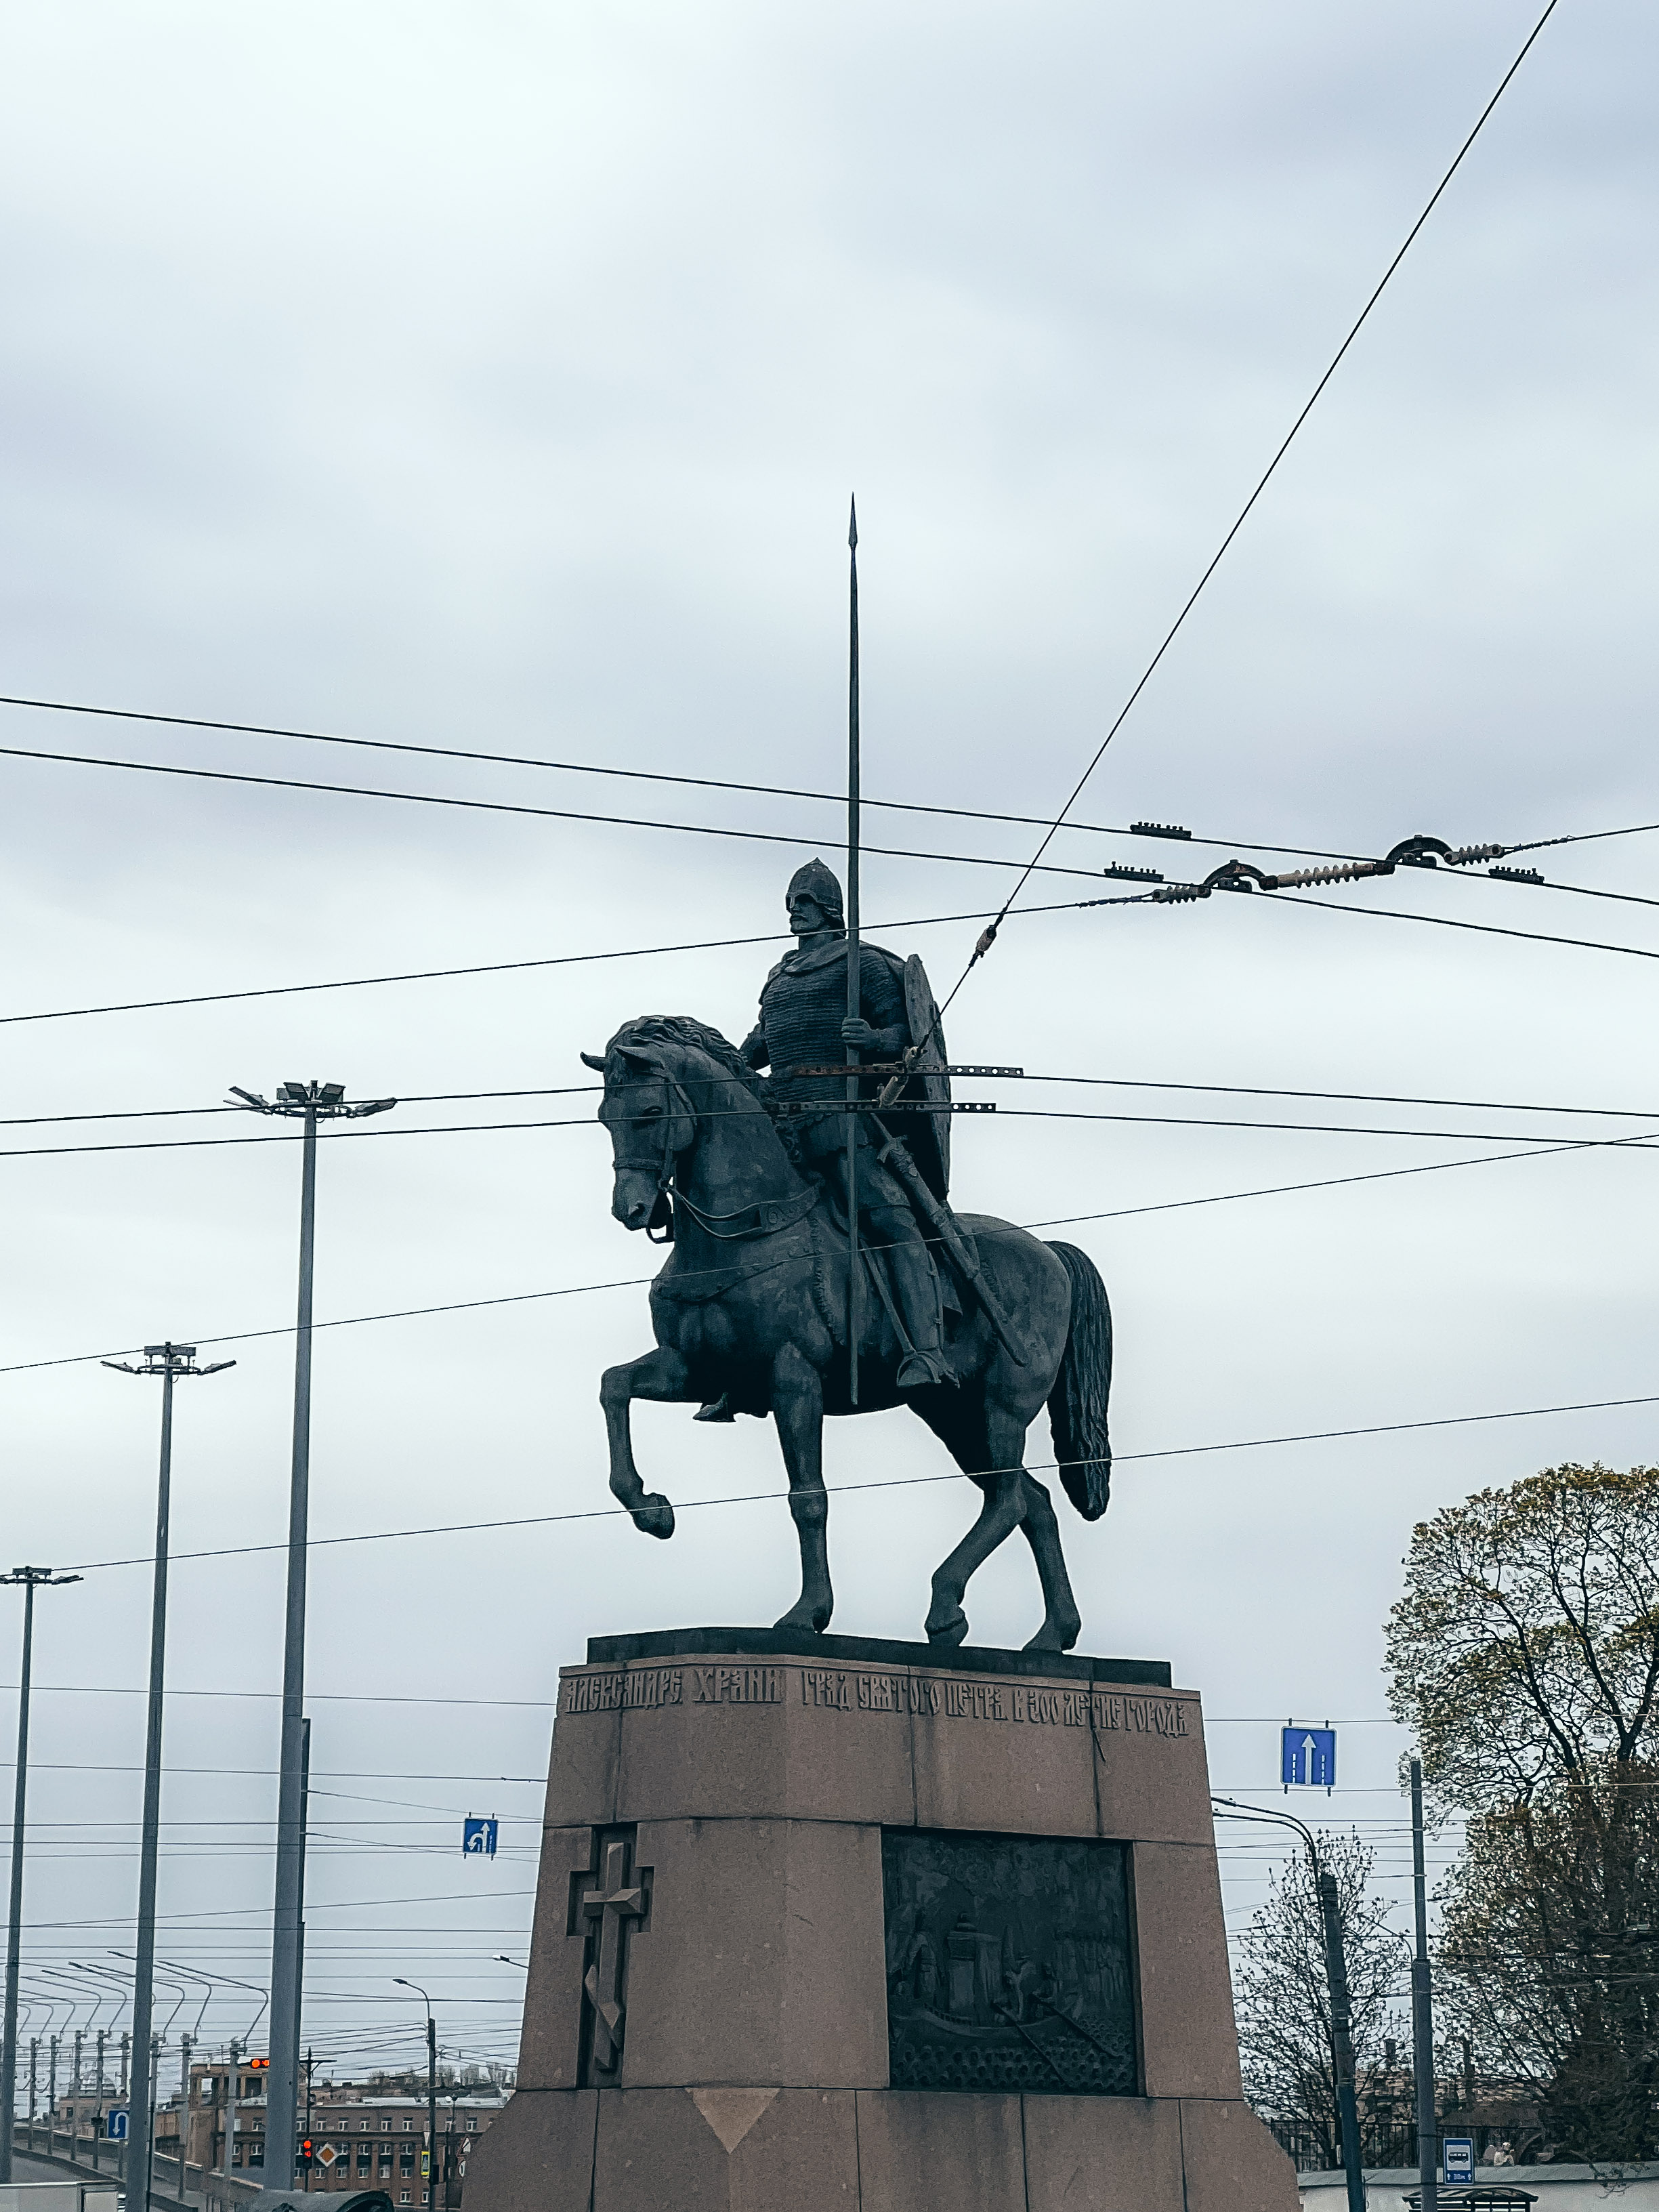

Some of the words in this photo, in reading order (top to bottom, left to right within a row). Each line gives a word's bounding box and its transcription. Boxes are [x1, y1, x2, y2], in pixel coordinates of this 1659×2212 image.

[692, 1667, 781, 1703] ХРАНИ
[802, 1670, 852, 1711] ГРАД
[858, 1674, 942, 1716] СВЯТОГО
[945, 1682, 1008, 1720] ПЕТРА
[1123, 1698, 1189, 1738] ГОРОДА
